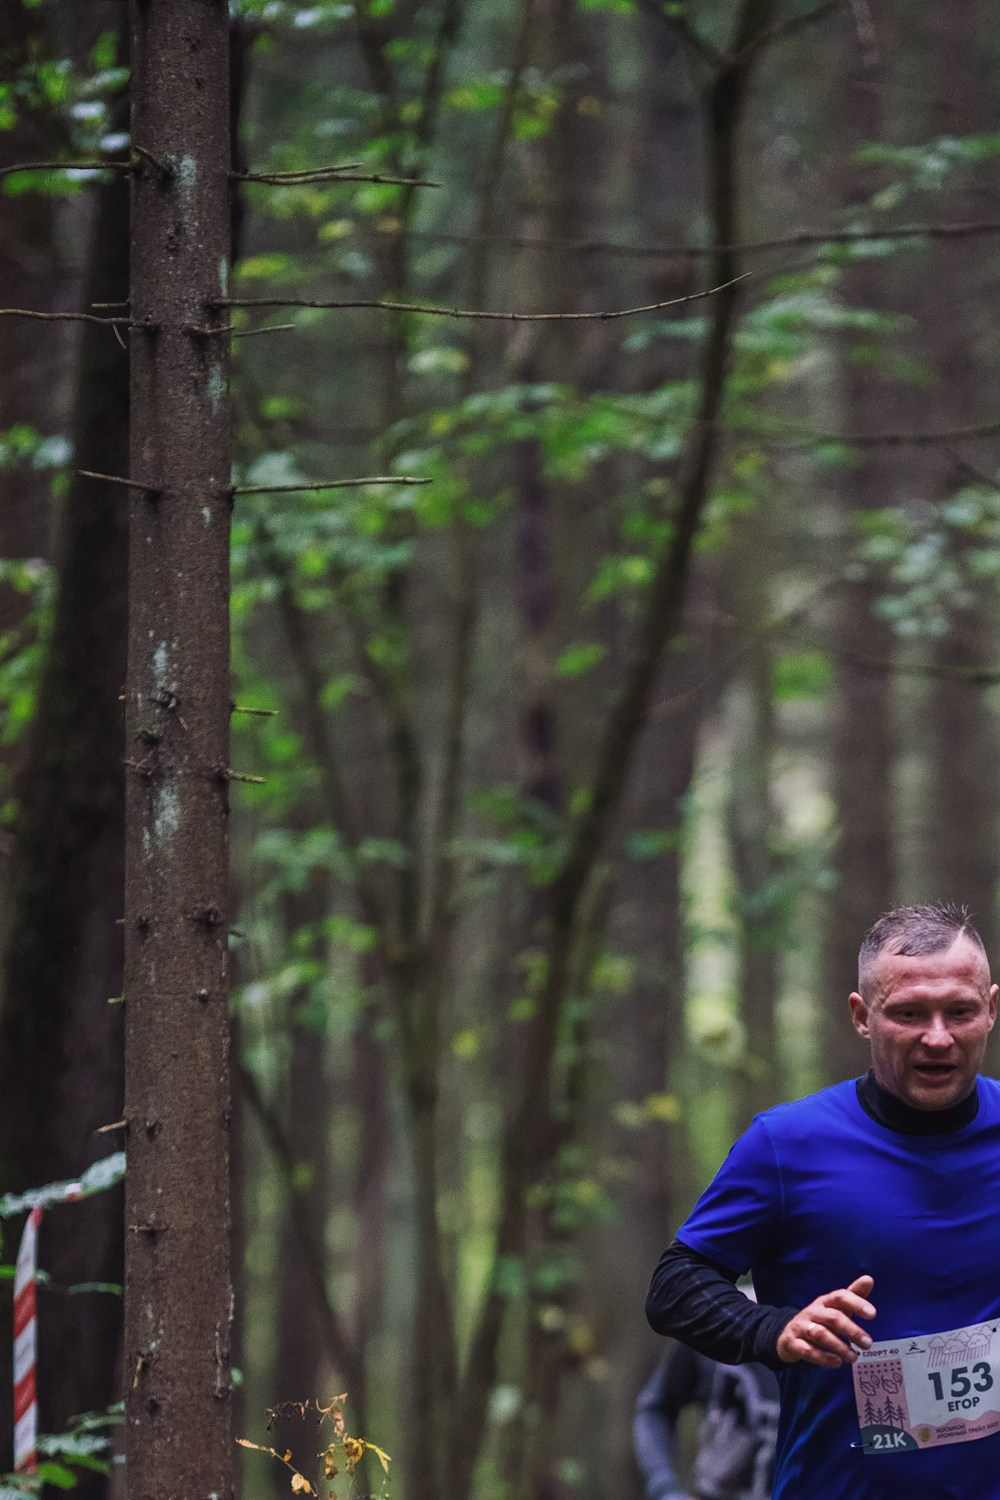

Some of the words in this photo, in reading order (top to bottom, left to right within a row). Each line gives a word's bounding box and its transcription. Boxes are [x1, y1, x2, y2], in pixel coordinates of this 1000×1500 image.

[862, 1349, 888, 1358] СПОРТ
[928, 1361, 994, 1401] 153
[947, 1396, 981, 1412] ЕГОР
